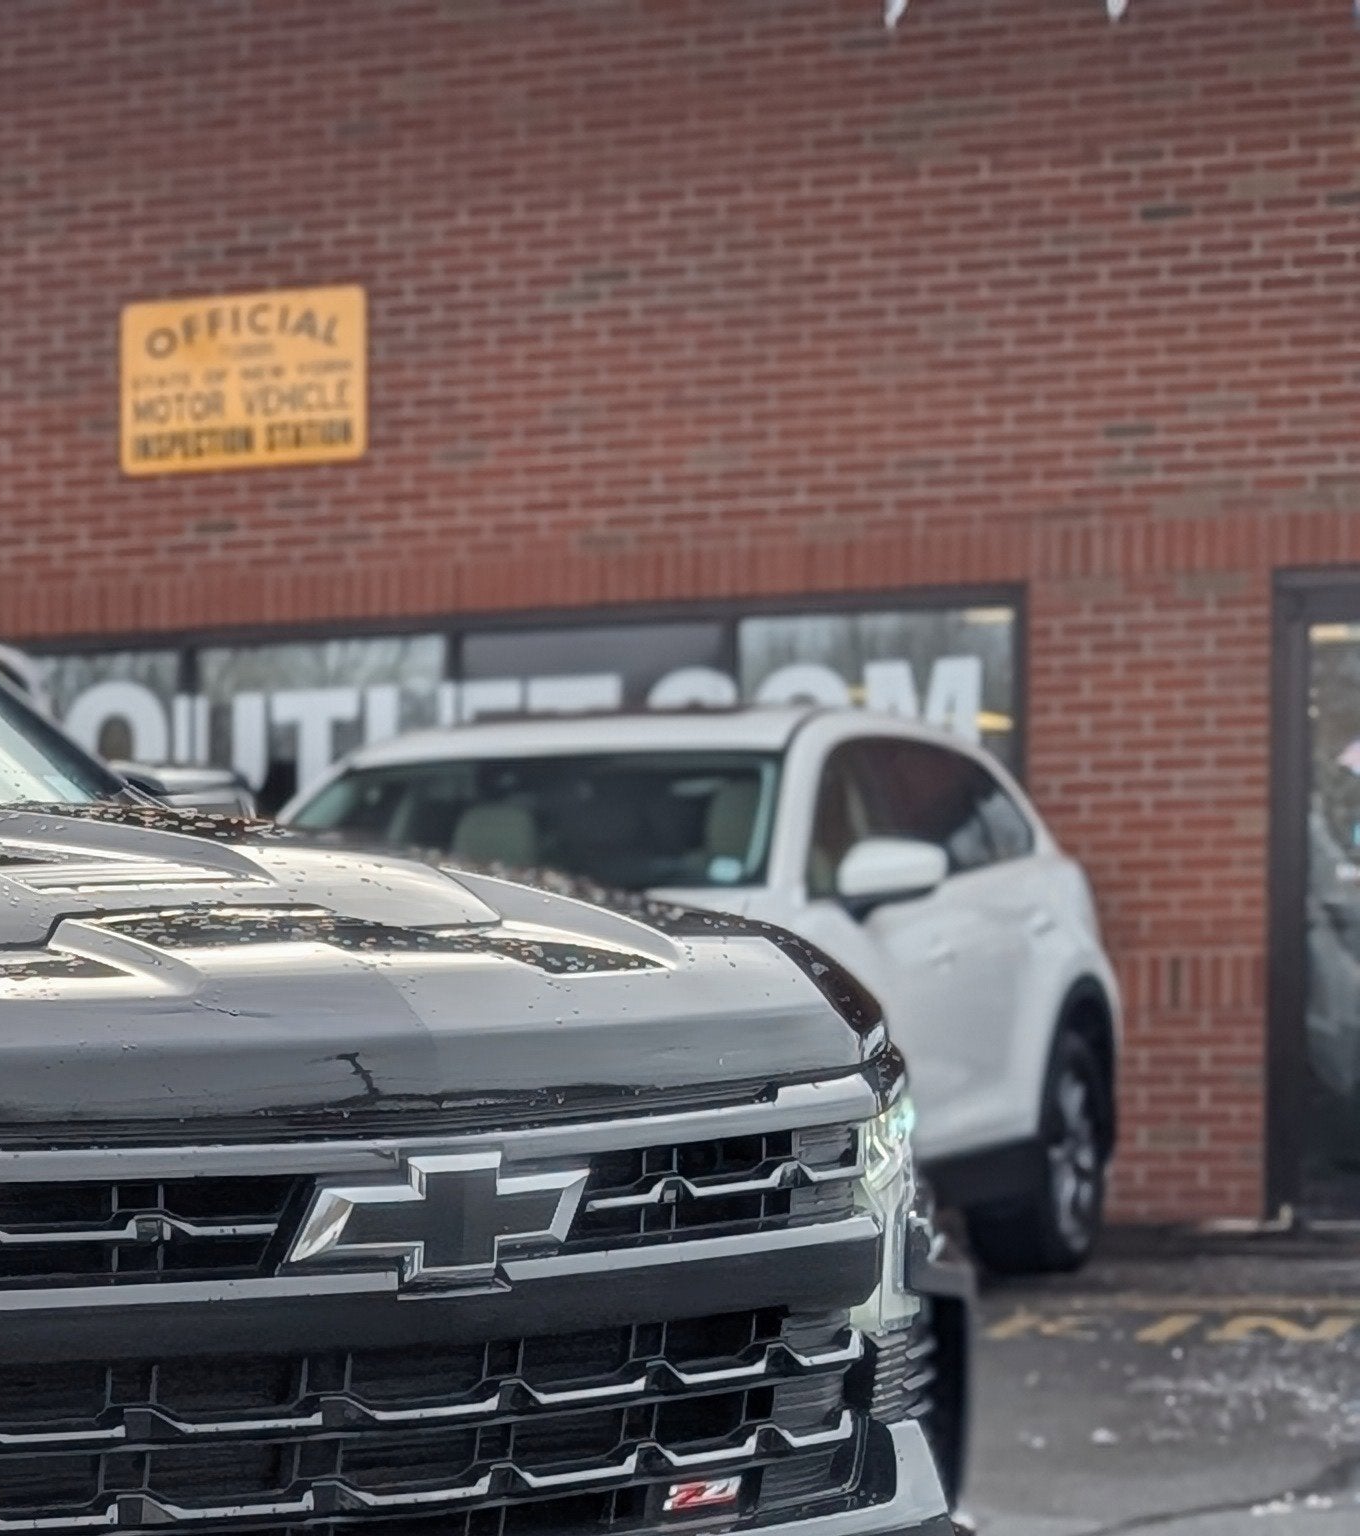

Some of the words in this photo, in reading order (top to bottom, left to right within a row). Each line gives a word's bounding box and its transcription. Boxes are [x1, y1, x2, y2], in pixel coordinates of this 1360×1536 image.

[145, 302, 338, 359] OFFICIAL
[133, 389, 225, 423] MOTOR
[240, 377, 352, 417] VEHICLE
